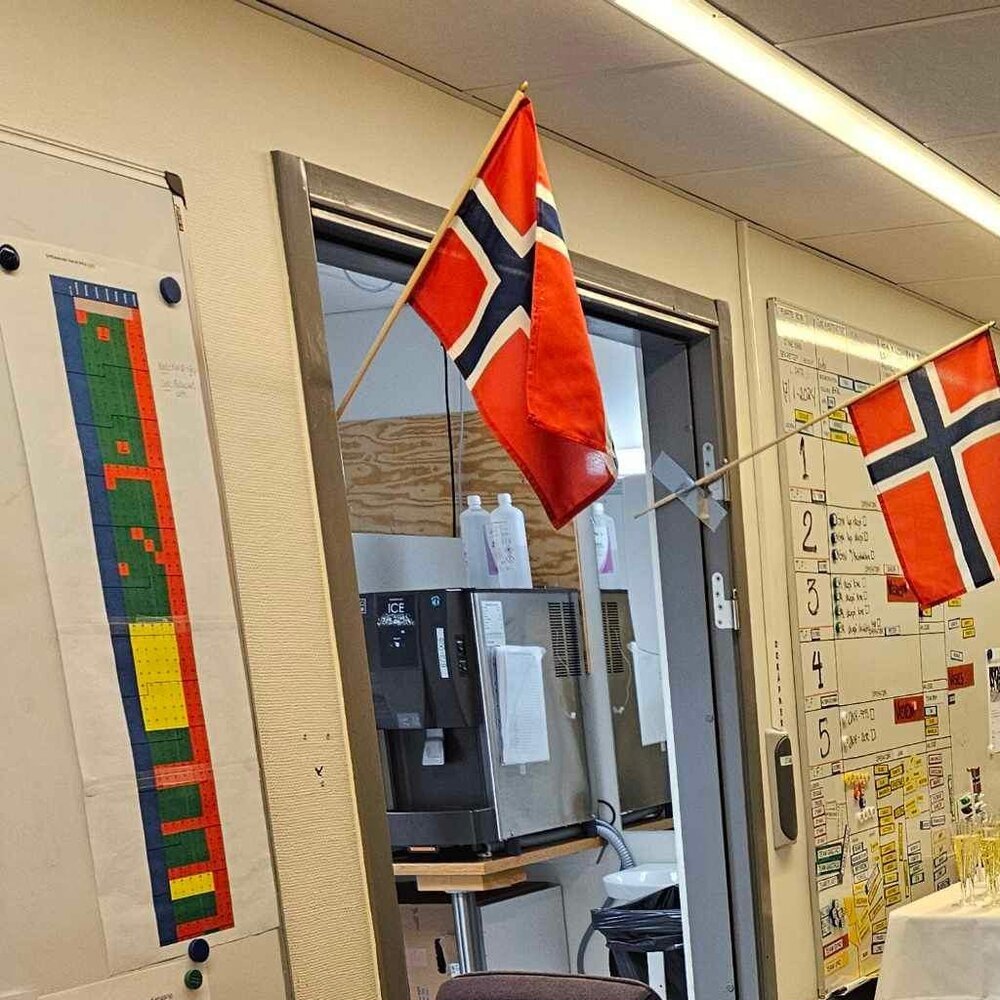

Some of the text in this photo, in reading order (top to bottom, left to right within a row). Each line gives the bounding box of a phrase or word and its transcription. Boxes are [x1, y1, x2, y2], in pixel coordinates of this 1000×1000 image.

[802, 510, 818, 553] 2
[387, 602, 405, 614] ICE
[806, 578, 820, 616] 3
[811, 650, 825, 689] 4
[818, 716, 832, 759] 5
